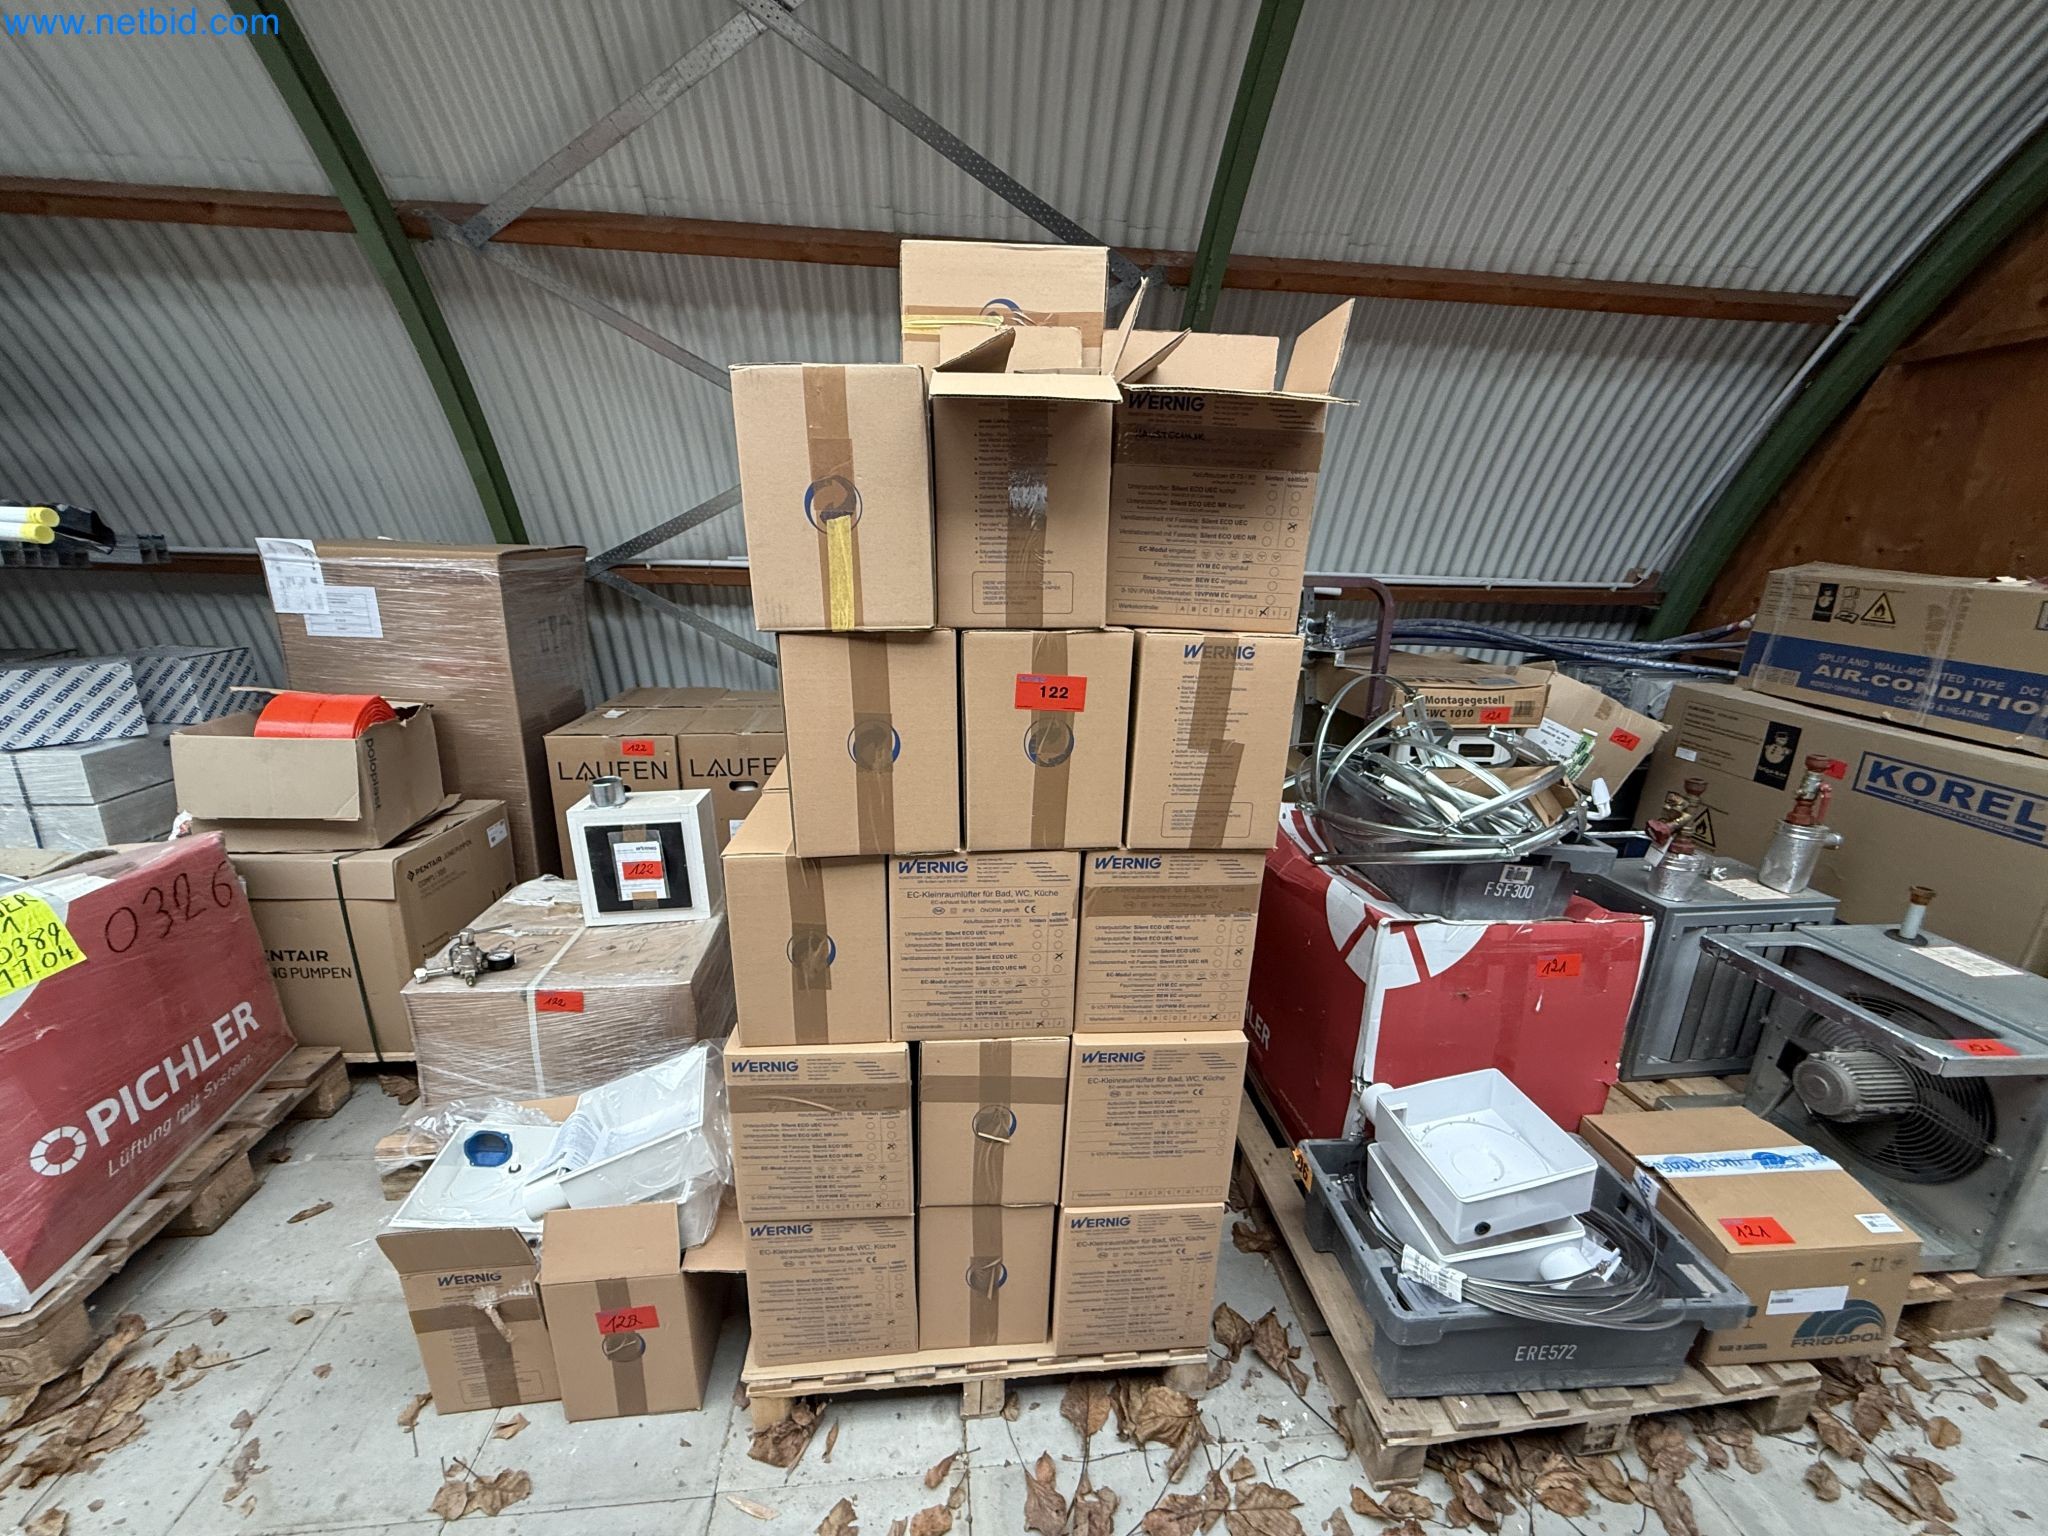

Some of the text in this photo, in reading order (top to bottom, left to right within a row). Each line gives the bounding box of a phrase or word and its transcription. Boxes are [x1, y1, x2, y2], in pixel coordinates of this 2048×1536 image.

[1128, 393, 1206, 411] WERNIG
[1184, 643, 1255, 660] WERNIG
[87, 671, 118, 698] HANSA
[1040, 686, 1069, 698] 122
[1972, 678, 2006, 690] TYPE
[2019, 685, 2041, 697] DC
[86, 696, 117, 722] HANSA
[1425, 695, 1505, 708] Montagegestell
[53, 702, 85, 730] HANSA
[1450, 708, 1474, 718] 1010
[1944, 706, 1990, 721] HEATING
[17, 708, 51, 736] HANSA
[558, 761, 668, 781] LAUFEN
[690, 757, 784, 779] LAUFE
[1867, 760, 2047, 831] KOREL
[628, 863, 654, 875] 122
[899, 858, 968, 874] WERNIG
[1095, 855, 1162, 870] WERNIG
[907, 890, 981, 898] EC-Kleinraumlüfter
[995, 890, 1014, 898] Bad,
[1015, 890, 1033, 898] WC,
[1484, 883, 1535, 900] FSF300
[1024, 906, 1036, 914] CE
[265, 950, 329, 962] NTAIR
[290, 967, 351, 979] PUMPEN
[1542, 958, 1567, 974] 121
[1082, 1050, 1146, 1064] WERNIG
[732, 1060, 798, 1072] WERNIG
[86, 1001, 260, 1147] PICHLER
[1192, 1088, 1204, 1096] CE
[107, 1121, 172, 1178] Lüftung
[1071, 1216, 1130, 1228] WERNIG
[750, 1224, 814, 1236] WERNIG
[1737, 1226, 1770, 1240] 121
[438, 1272, 502, 1287] WERNIG
[1791, 1332, 1885, 1348] FRIGOPOL
[1514, 1345, 1577, 1362] ERE572
